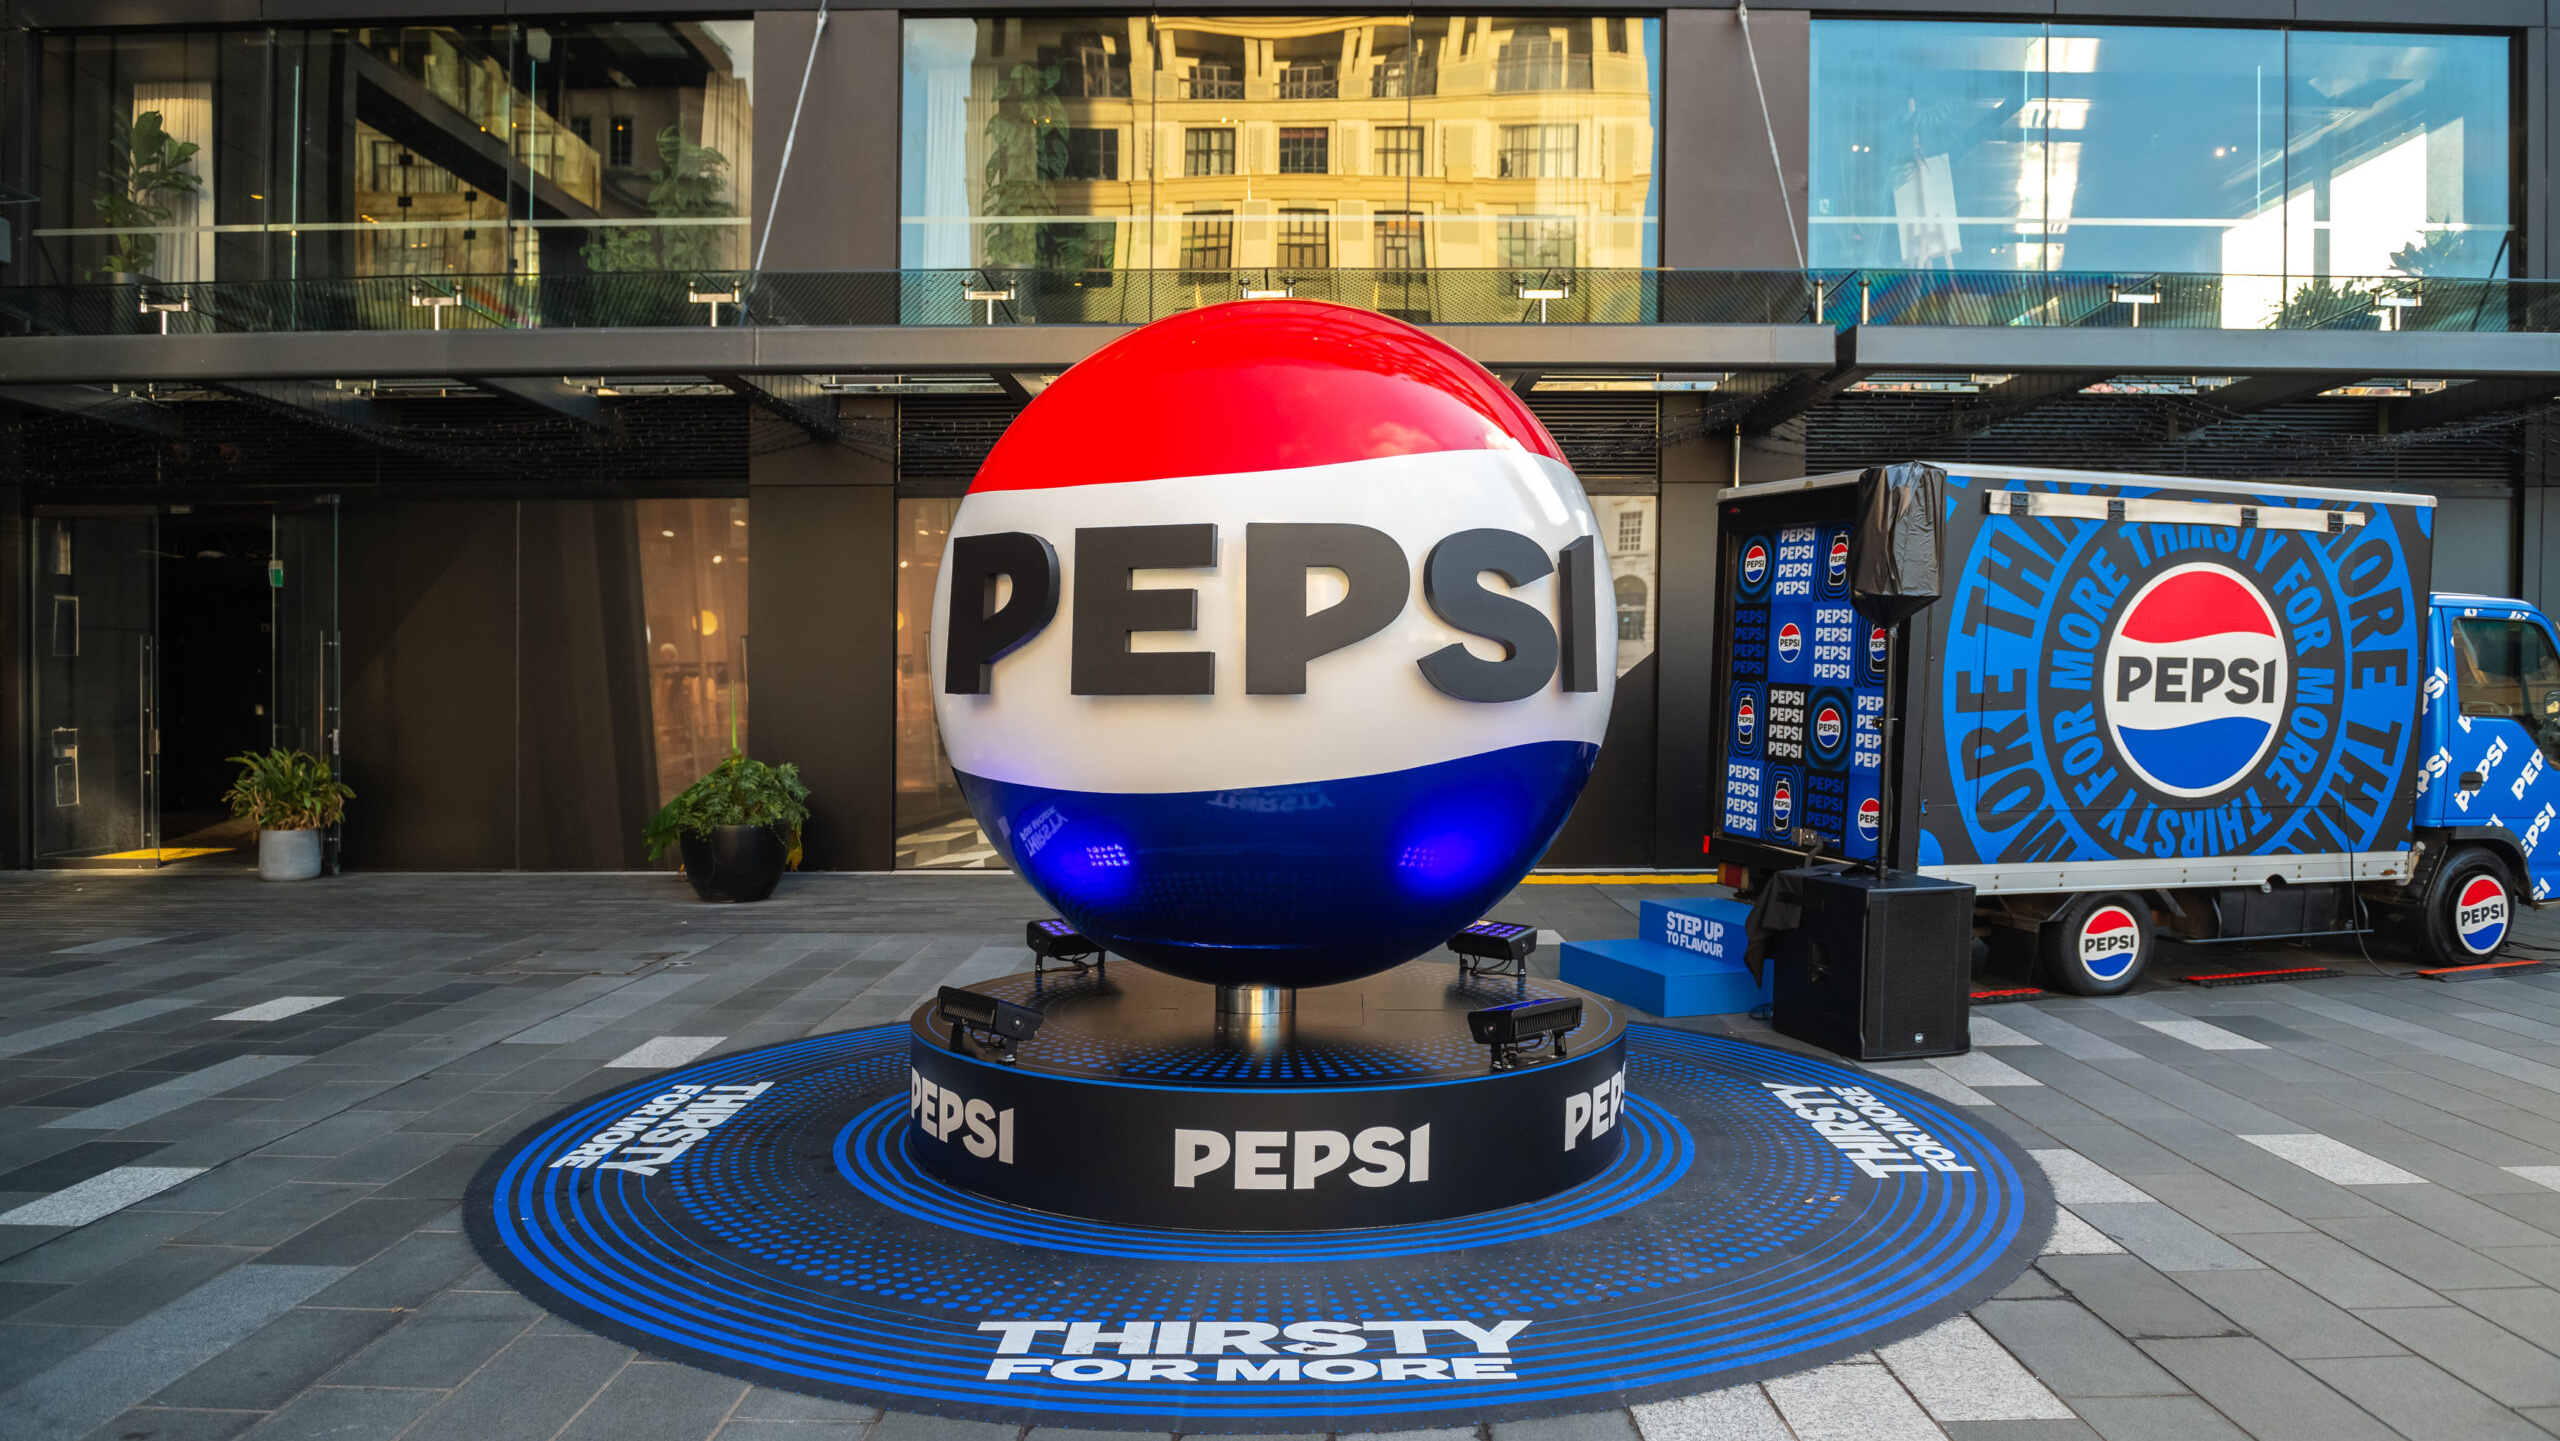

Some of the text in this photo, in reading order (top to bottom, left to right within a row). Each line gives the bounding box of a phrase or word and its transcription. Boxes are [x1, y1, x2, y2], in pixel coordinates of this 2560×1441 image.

[1781, 528, 1816, 543] PEPSI
[1779, 545, 1814, 561] PEPSI
[1831, 555, 1846, 563] PEPS
[1746, 560, 1765, 568] PEPSI
[1778, 563, 1812, 578] PEPSI
[1775, 580, 1810, 596] PEPSI
[945, 522, 1598, 703] PEPSI
[2272, 557, 2332, 657] FOR
[1736, 610, 1767, 624] PEPSI
[1816, 609, 1853, 624] PEPSI
[2050, 546, 2131, 691] MORE
[1735, 627, 1766, 640] PEPSI
[1815, 627, 1852, 643] PEPSI
[1734, 644, 1765, 657] PEPSI
[1780, 638, 1800, 648] PEPSI
[1871, 641, 1886, 649] PEPS
[1814, 645, 1851, 661] PEPSI
[1733, 660, 1764, 675] PEPSI
[1813, 663, 1850, 679] PEPSI
[2116, 655, 2278, 705] PEPSI
[1770, 689, 1805, 706] PEPSI
[1857, 695, 1884, 711] PEP
[1739, 716, 1753, 724] PEPSI
[1769, 707, 1804, 723] PEPSI
[1768, 724, 1803, 741] PEPSI
[1819, 723, 1839, 732] PEPSI
[2265, 667, 2336, 804] MORE
[1855, 733, 1882, 749] PEP
[1768, 741, 1802, 759] PEPSI
[1854, 751, 1881, 768] PEP
[1728, 764, 1760, 781] PEPSI
[2053, 701, 2274, 859] THIRSTY FOR
[2417, 745, 2453, 800] PSI
[2454, 735, 2509, 813] PPSI
[2510, 748, 2545, 801] PEP
[1727, 781, 1759, 798] PEPSI
[1808, 775, 1844, 794] PEPSI
[1726, 797, 1758, 815] PEPSI
[1774, 800, 1790, 809] PEPSI
[1807, 793, 1844, 812] PEPSI
[1725, 813, 1757, 832] PEPSI
[1806, 811, 1842, 831] PEPSI
[1859, 813, 1880, 825] PEPS
[2460, 902, 2505, 927] PEPSI
[1666, 910, 1724, 942] STEP UP
[1666, 930, 1723, 958] TO FLAVOUR
[2084, 934, 2135, 954] PEPSI
[1564, 1060, 1625, 1152] PEP
[911, 1066, 1014, 1165] PEPSI
[549, 1084, 707, 1169] FOR MORE
[597, 1081, 775, 1176] THIRSTY
[1761, 1082, 1929, 1178] THIRSTY
[1829, 1086, 1977, 1172] FOR MORE
[1173, 1123, 1430, 1190] PEPSI
[977, 1320, 1533, 1356] THIRSTY
[985, 1357, 1518, 1382] FOR MORE
